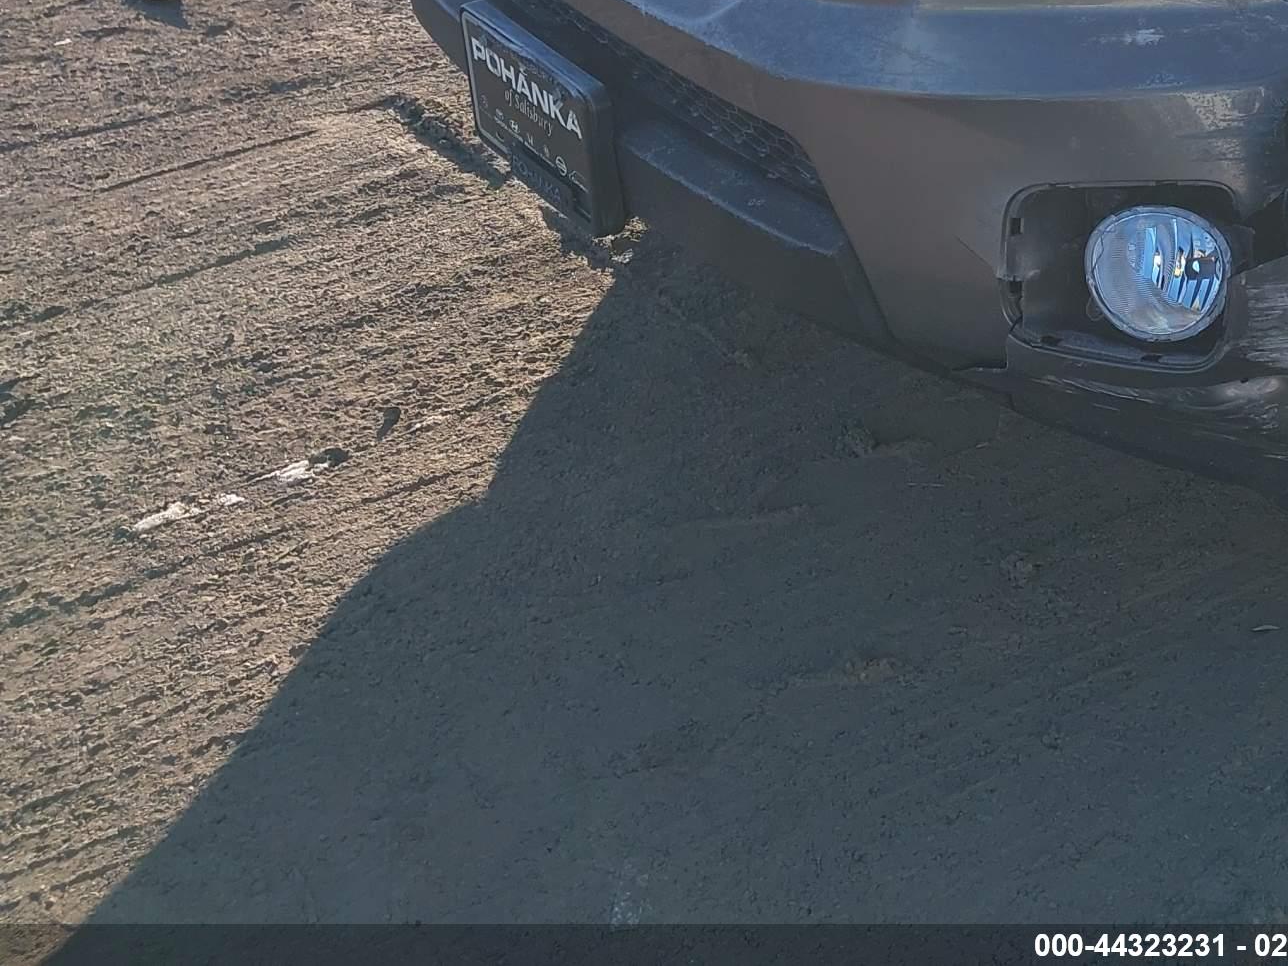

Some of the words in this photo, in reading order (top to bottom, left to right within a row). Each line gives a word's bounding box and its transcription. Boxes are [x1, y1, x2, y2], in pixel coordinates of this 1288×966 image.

[470, 36, 583, 140] POHANKA
[504, 89, 513, 107] of
[514, 94, 554, 137] Salisbury
